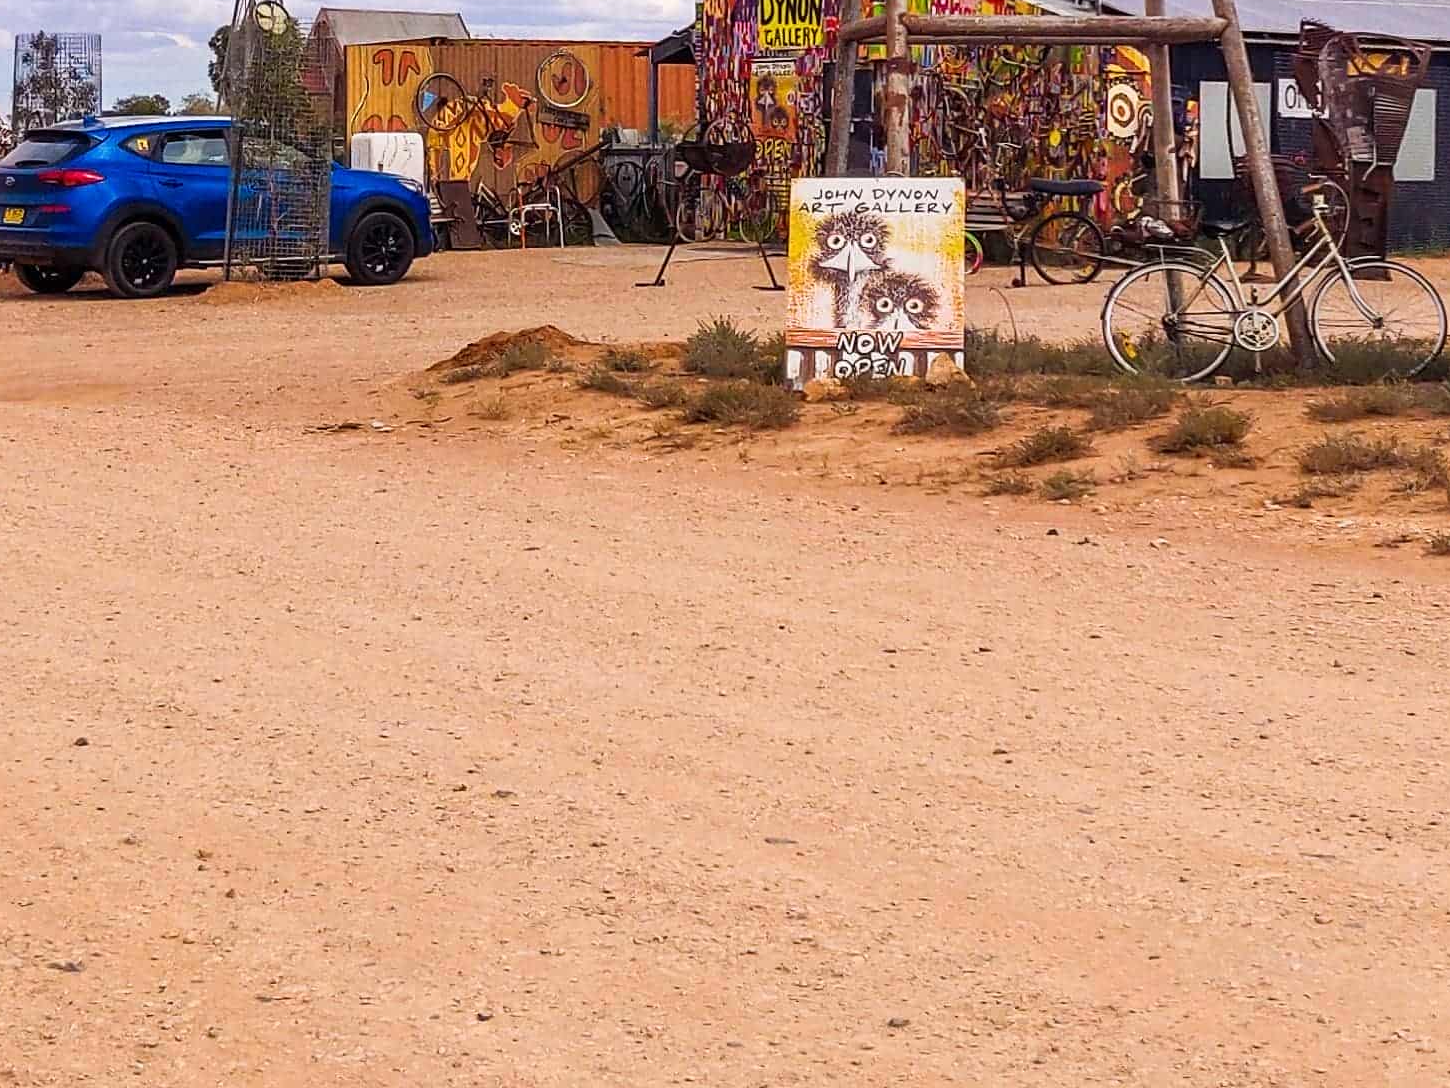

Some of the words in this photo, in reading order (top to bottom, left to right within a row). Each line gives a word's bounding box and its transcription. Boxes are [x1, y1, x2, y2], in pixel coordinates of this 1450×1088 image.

[763, 27, 819, 47] GALLERY
[812, 189, 864, 201] JOHN
[871, 189, 939, 201] DYNON
[798, 202, 845, 213] ART
[854, 202, 953, 213] GALLERY
[837, 330, 904, 354] NOW
[834, 358, 906, 380] OPEN
